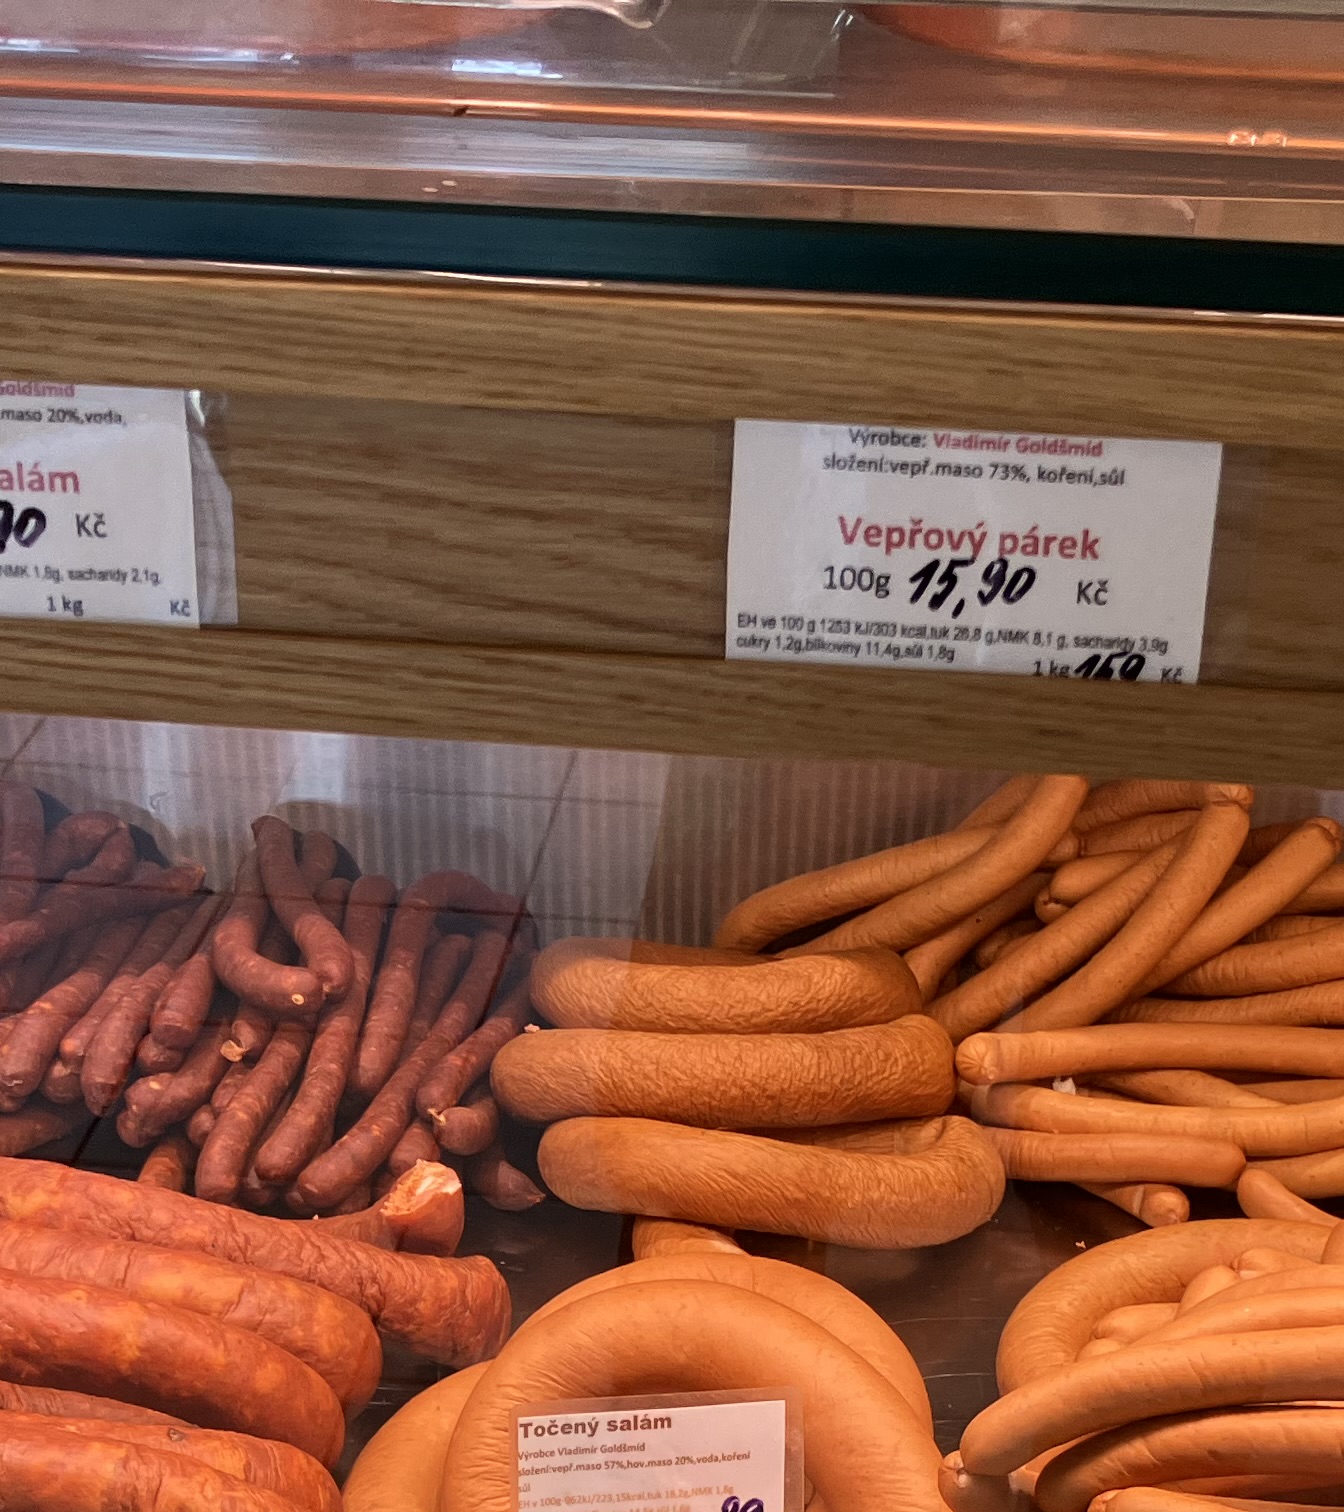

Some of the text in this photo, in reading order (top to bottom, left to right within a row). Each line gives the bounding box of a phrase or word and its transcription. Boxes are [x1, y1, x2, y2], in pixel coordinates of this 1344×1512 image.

[849, 429, 927, 449] Výrobce:
[76, 513, 108, 539] Kč
[838, 516, 1102, 560] Vepřový párek
[823, 556, 1109, 619] 100g 15,90 Kč
[47, 595, 190, 617] 1 kg Kč
[519, 1413, 672, 1438] Točený salám
